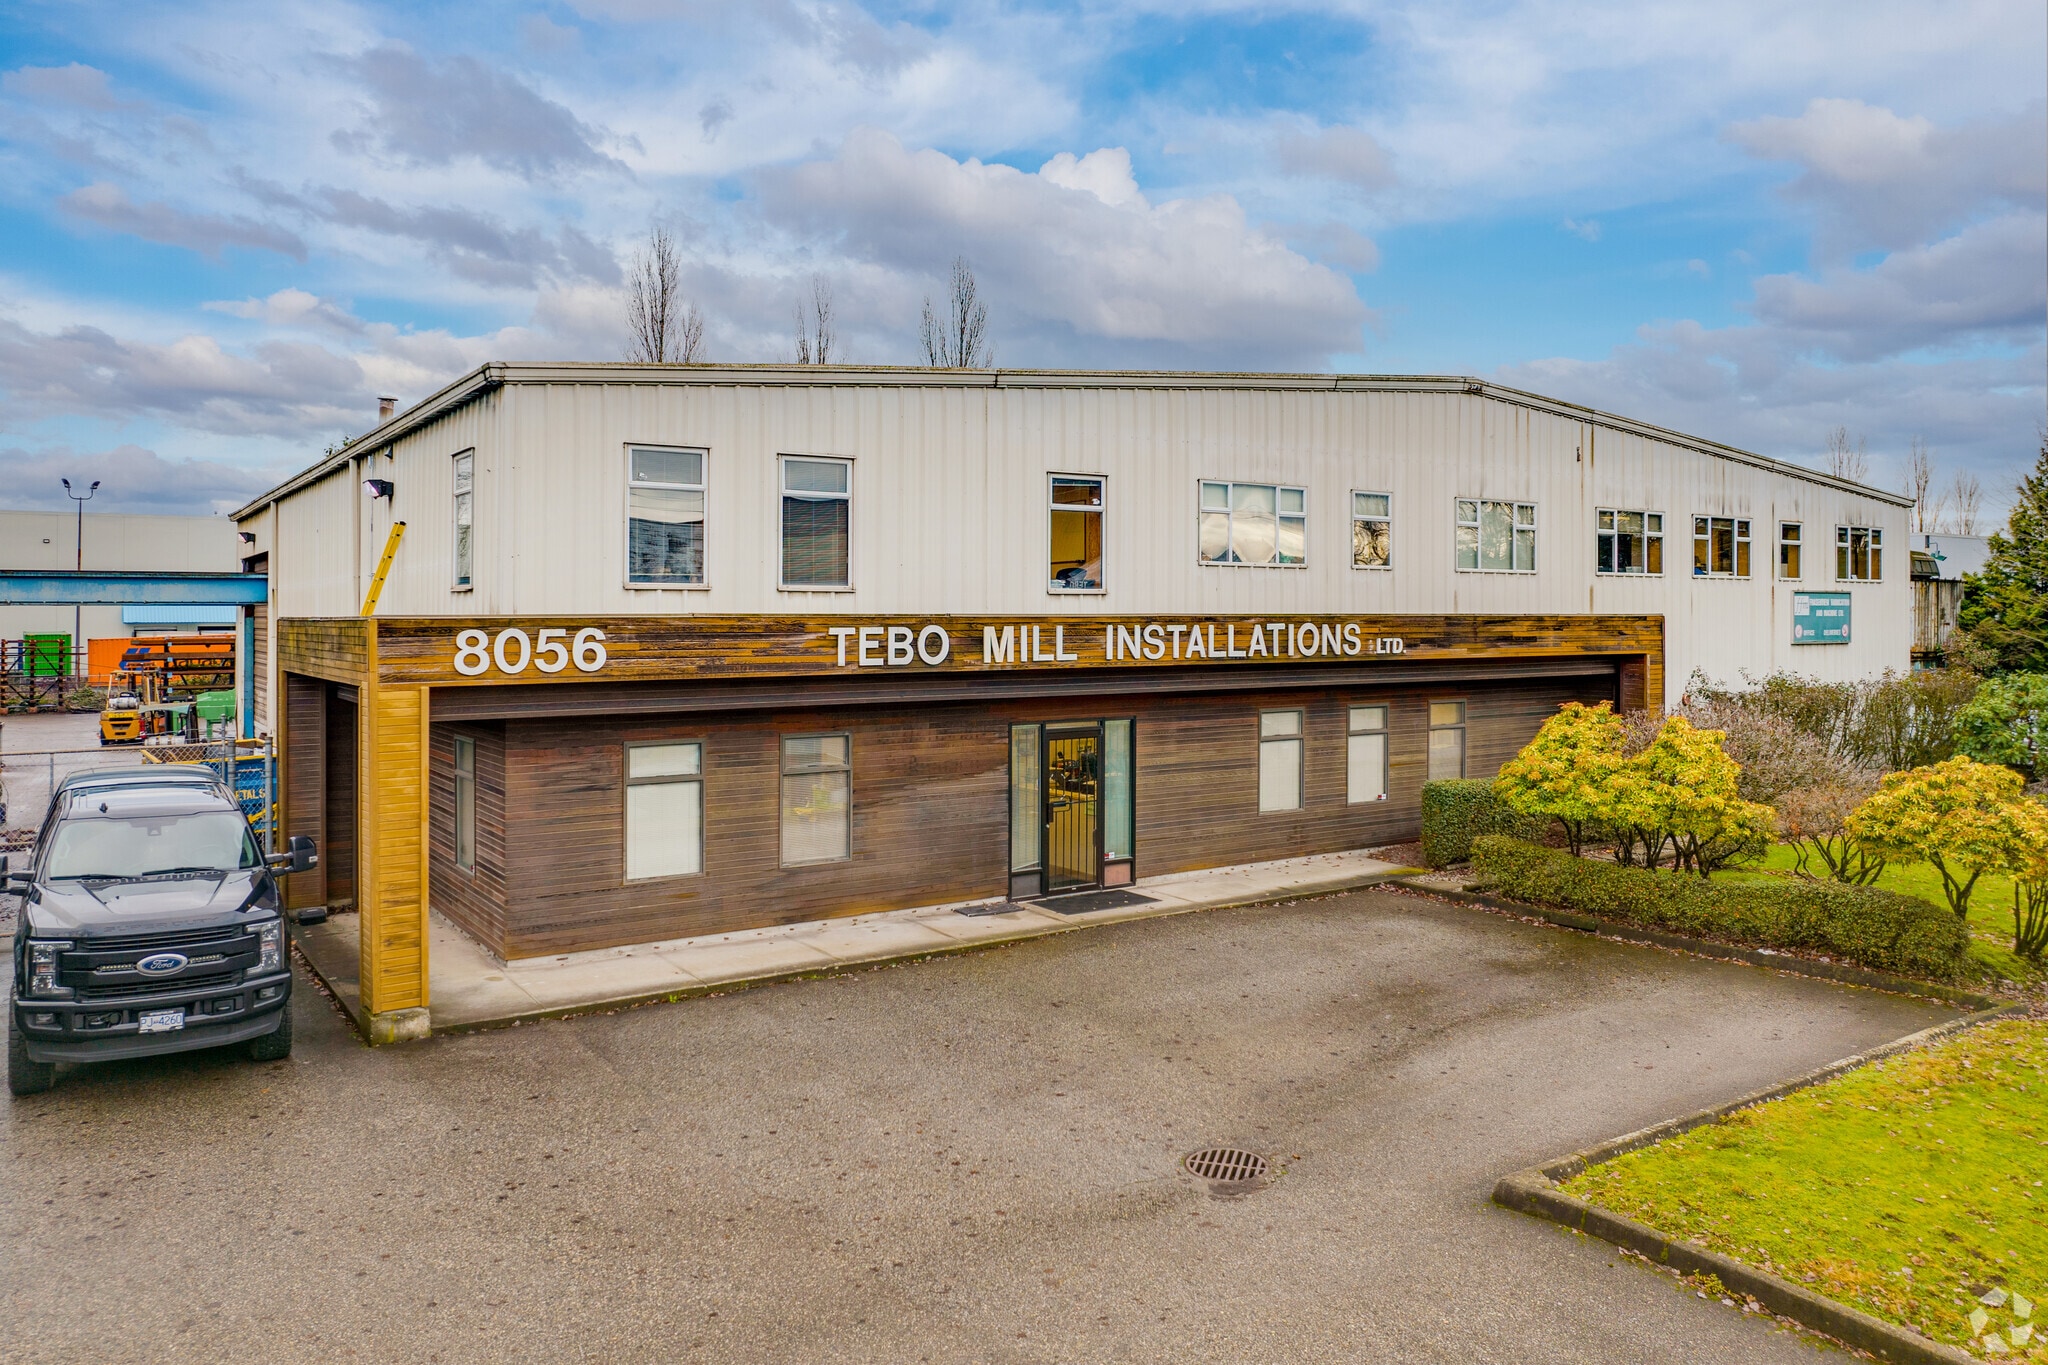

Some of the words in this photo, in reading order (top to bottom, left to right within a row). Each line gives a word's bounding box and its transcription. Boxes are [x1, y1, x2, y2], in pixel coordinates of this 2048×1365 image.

[454, 627, 608, 676] 8056
[828, 625, 950, 667] TEBO
[983, 625, 1078, 663] MILL
[1106, 623, 1361, 660] INSTALLATIONS
[150, 959, 175, 970] Ford
